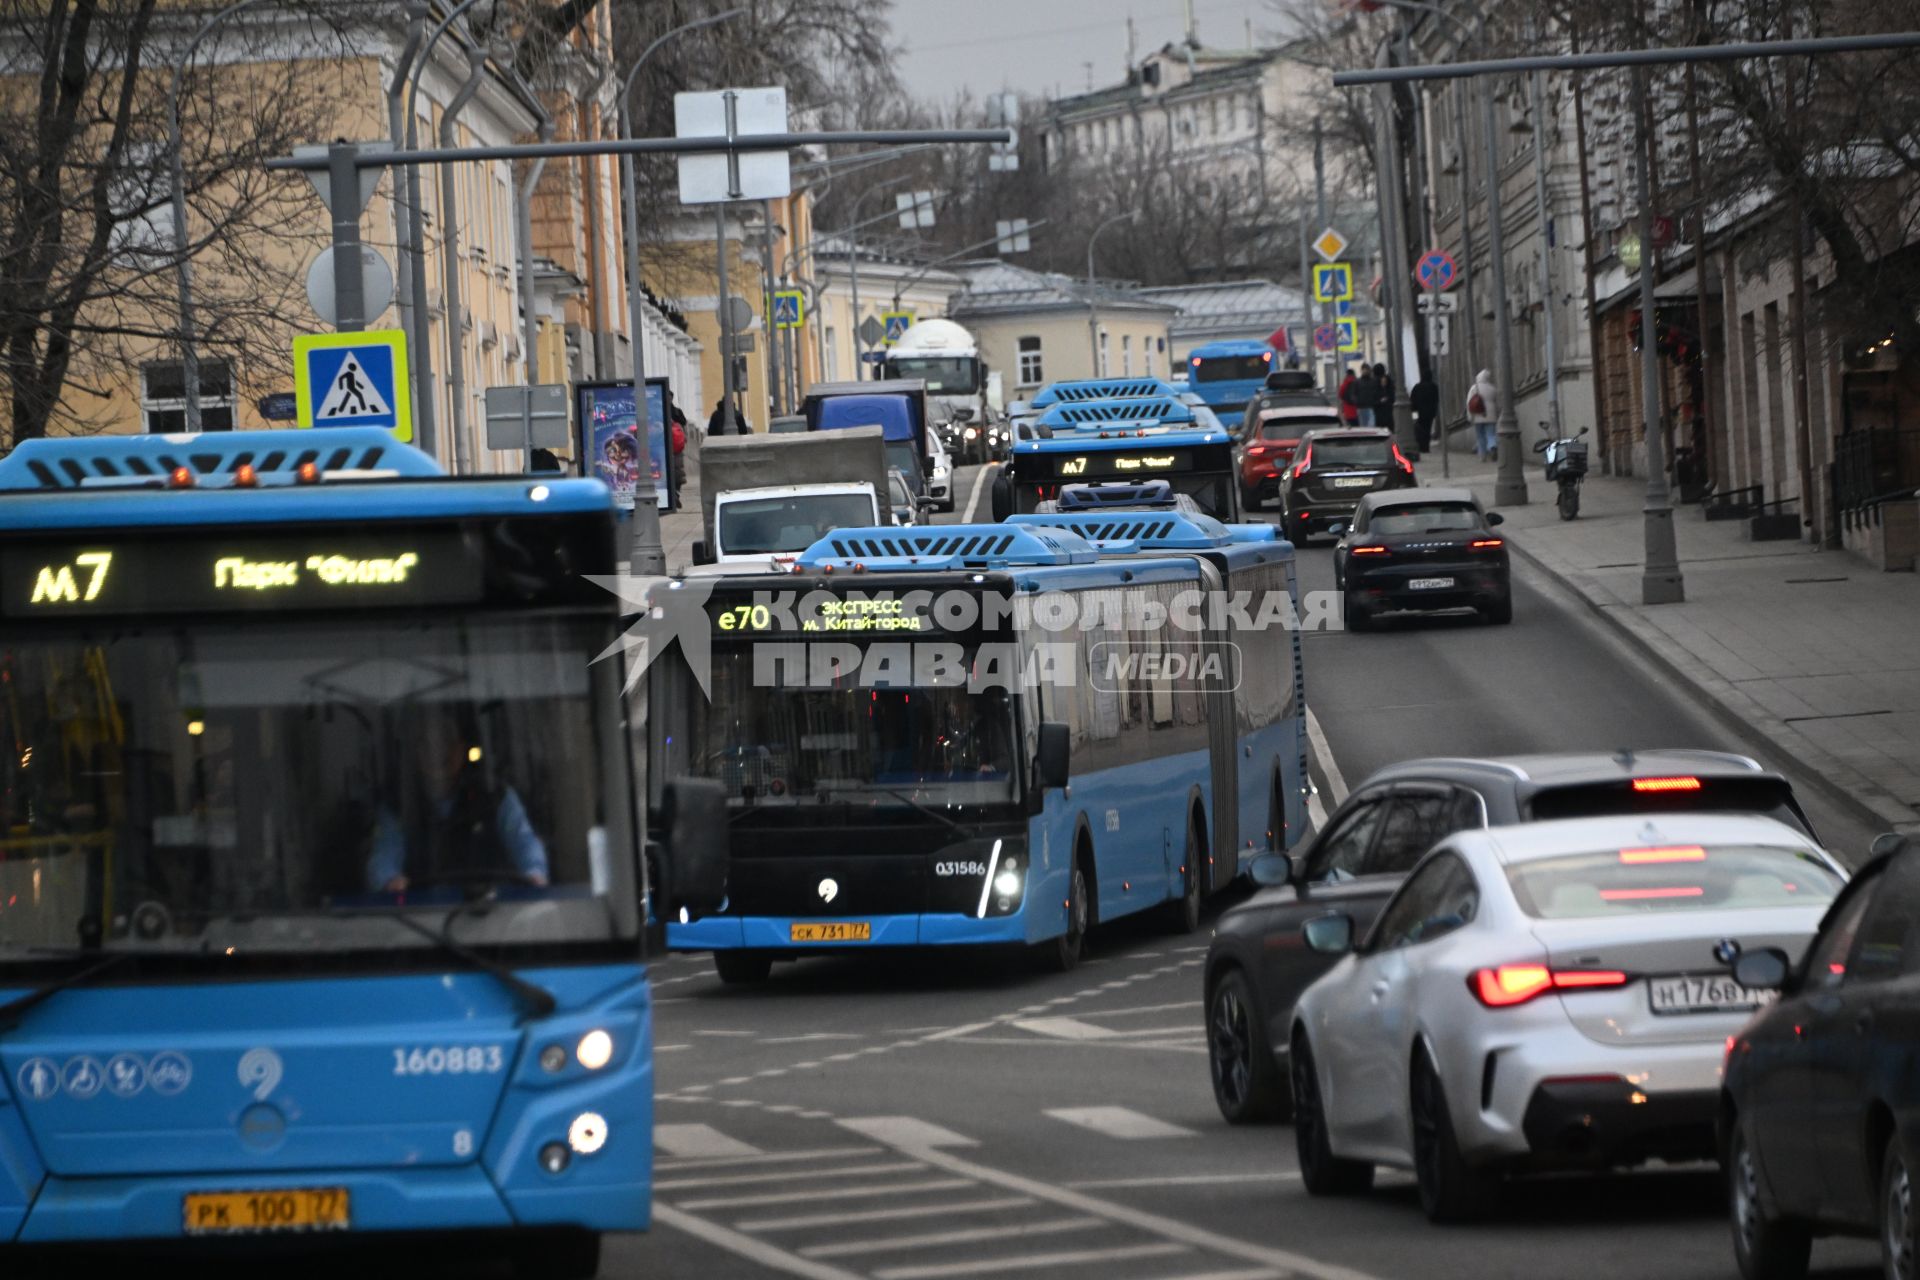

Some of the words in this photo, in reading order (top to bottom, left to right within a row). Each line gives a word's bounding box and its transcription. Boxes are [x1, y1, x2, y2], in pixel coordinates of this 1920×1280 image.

[215, 557, 298, 589] Парк
[821, 600, 904, 616] ЭКСПРЕСС
[825, 615, 921, 631] Китай-город
[935, 861, 986, 876] 031586
[393, 1046, 502, 1075] 160883
[453, 1130, 472, 1157] 8
